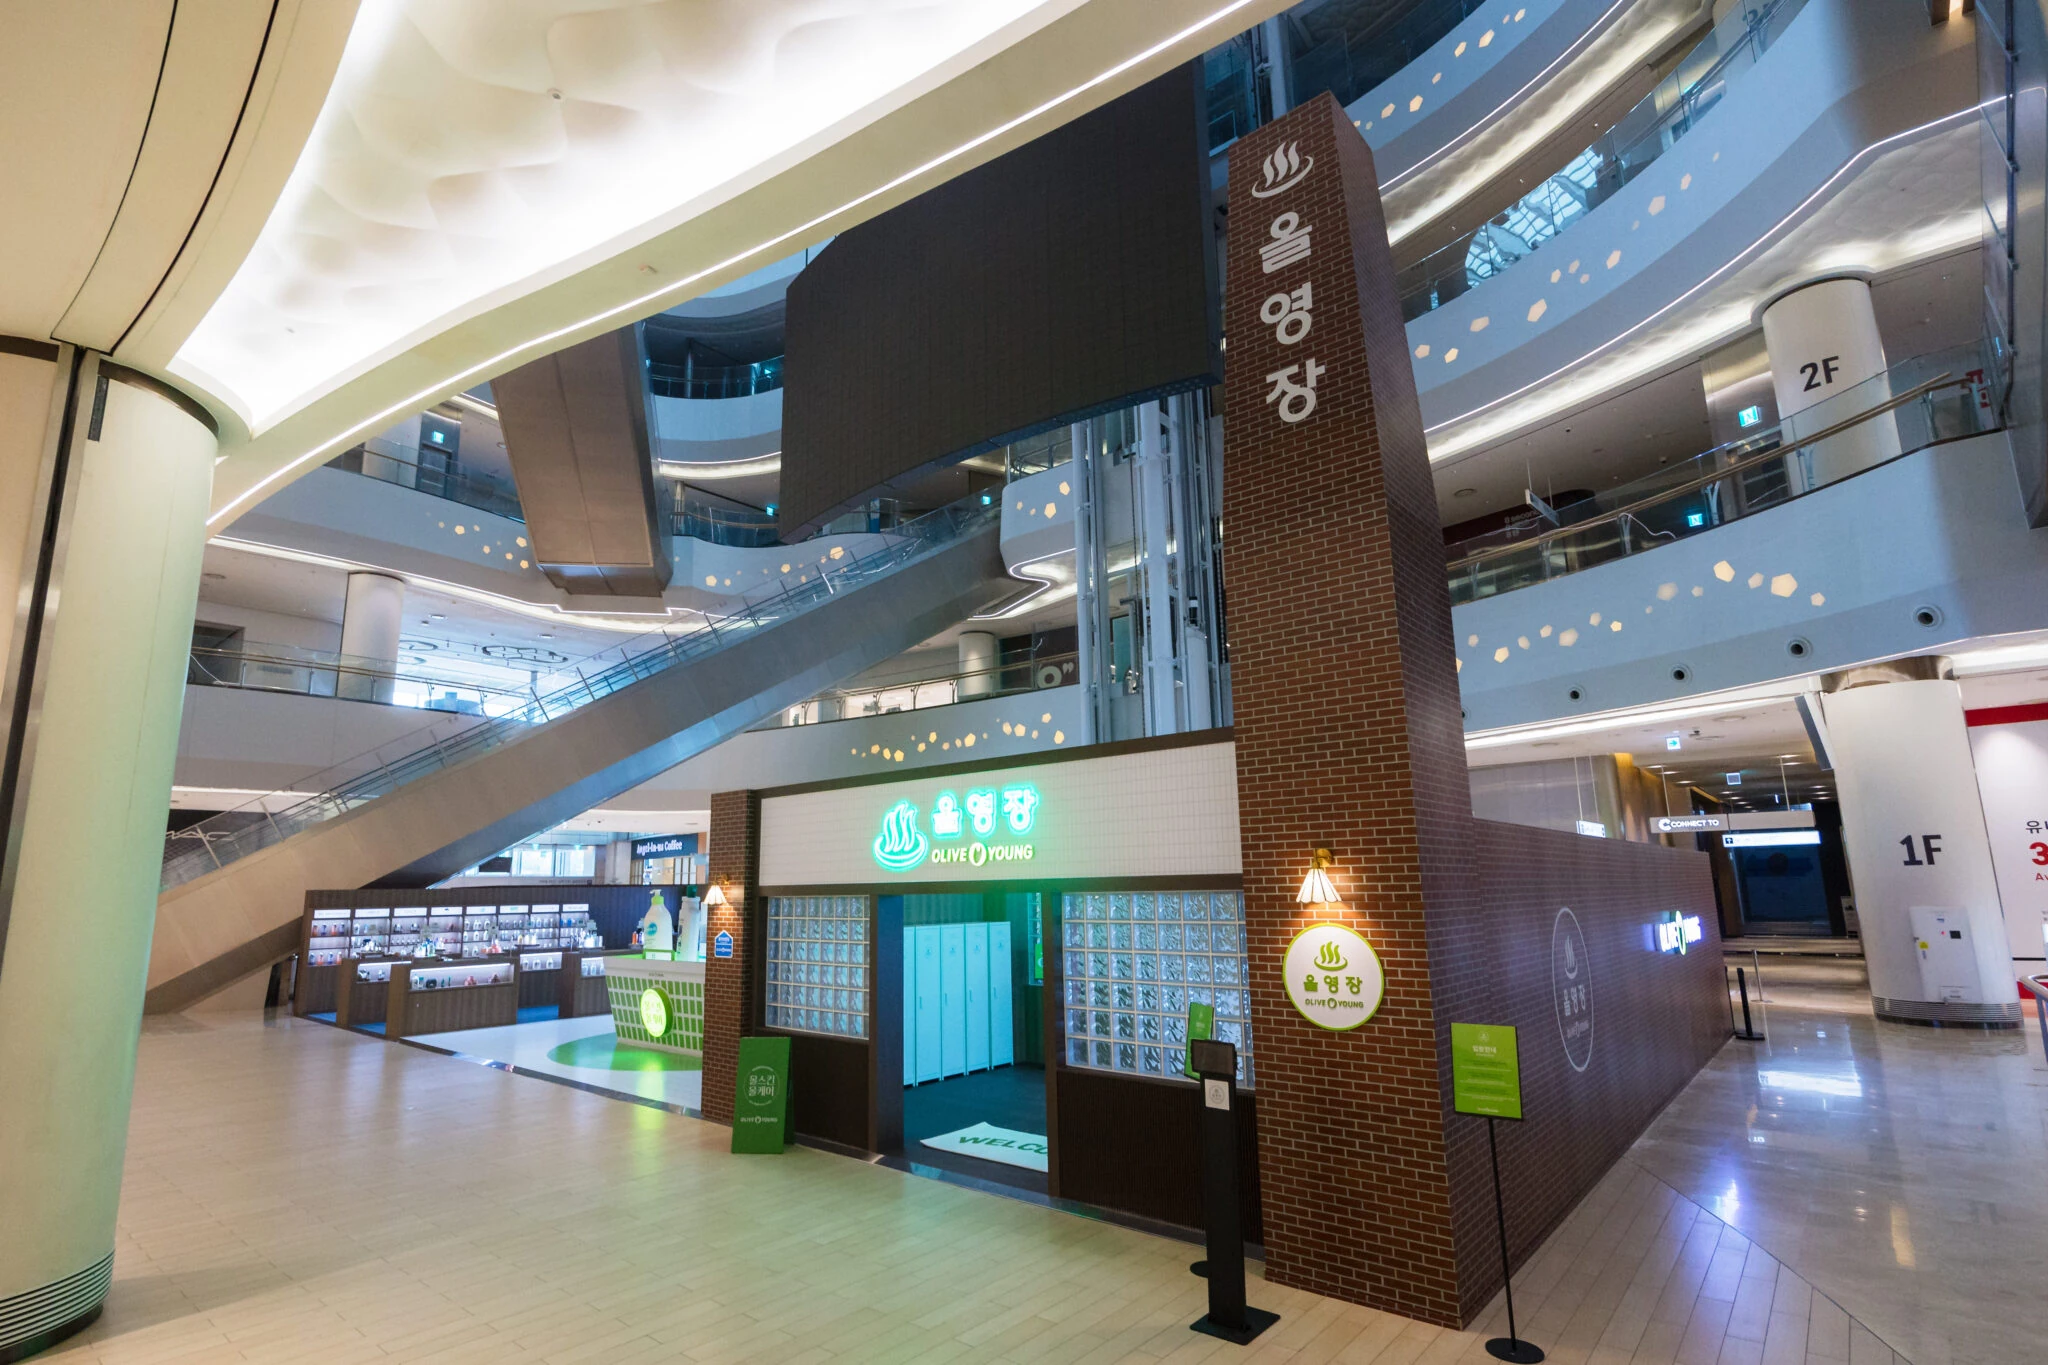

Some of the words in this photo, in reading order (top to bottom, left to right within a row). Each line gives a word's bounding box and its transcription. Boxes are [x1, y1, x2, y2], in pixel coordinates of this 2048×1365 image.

[1259, 212, 1325, 423] 올영장
[1800, 356, 1839, 392] 2F
[932, 788, 1036, 835] 올영장
[1671, 820, 1707, 828] CONNECT
[1708, 819, 1719, 827] TO
[2026, 820, 2048, 834] 유
[665, 839, 682, 851] Coffee
[931, 848, 967, 863] OLIVE
[988, 844, 1033, 861] YOUNG
[1899, 834, 1942, 866] 1F
[1303, 974, 1363, 995] 올영장
[1305, 998, 1326, 1006] OLIVE
[1338, 1000, 1364, 1008] YOUNG
